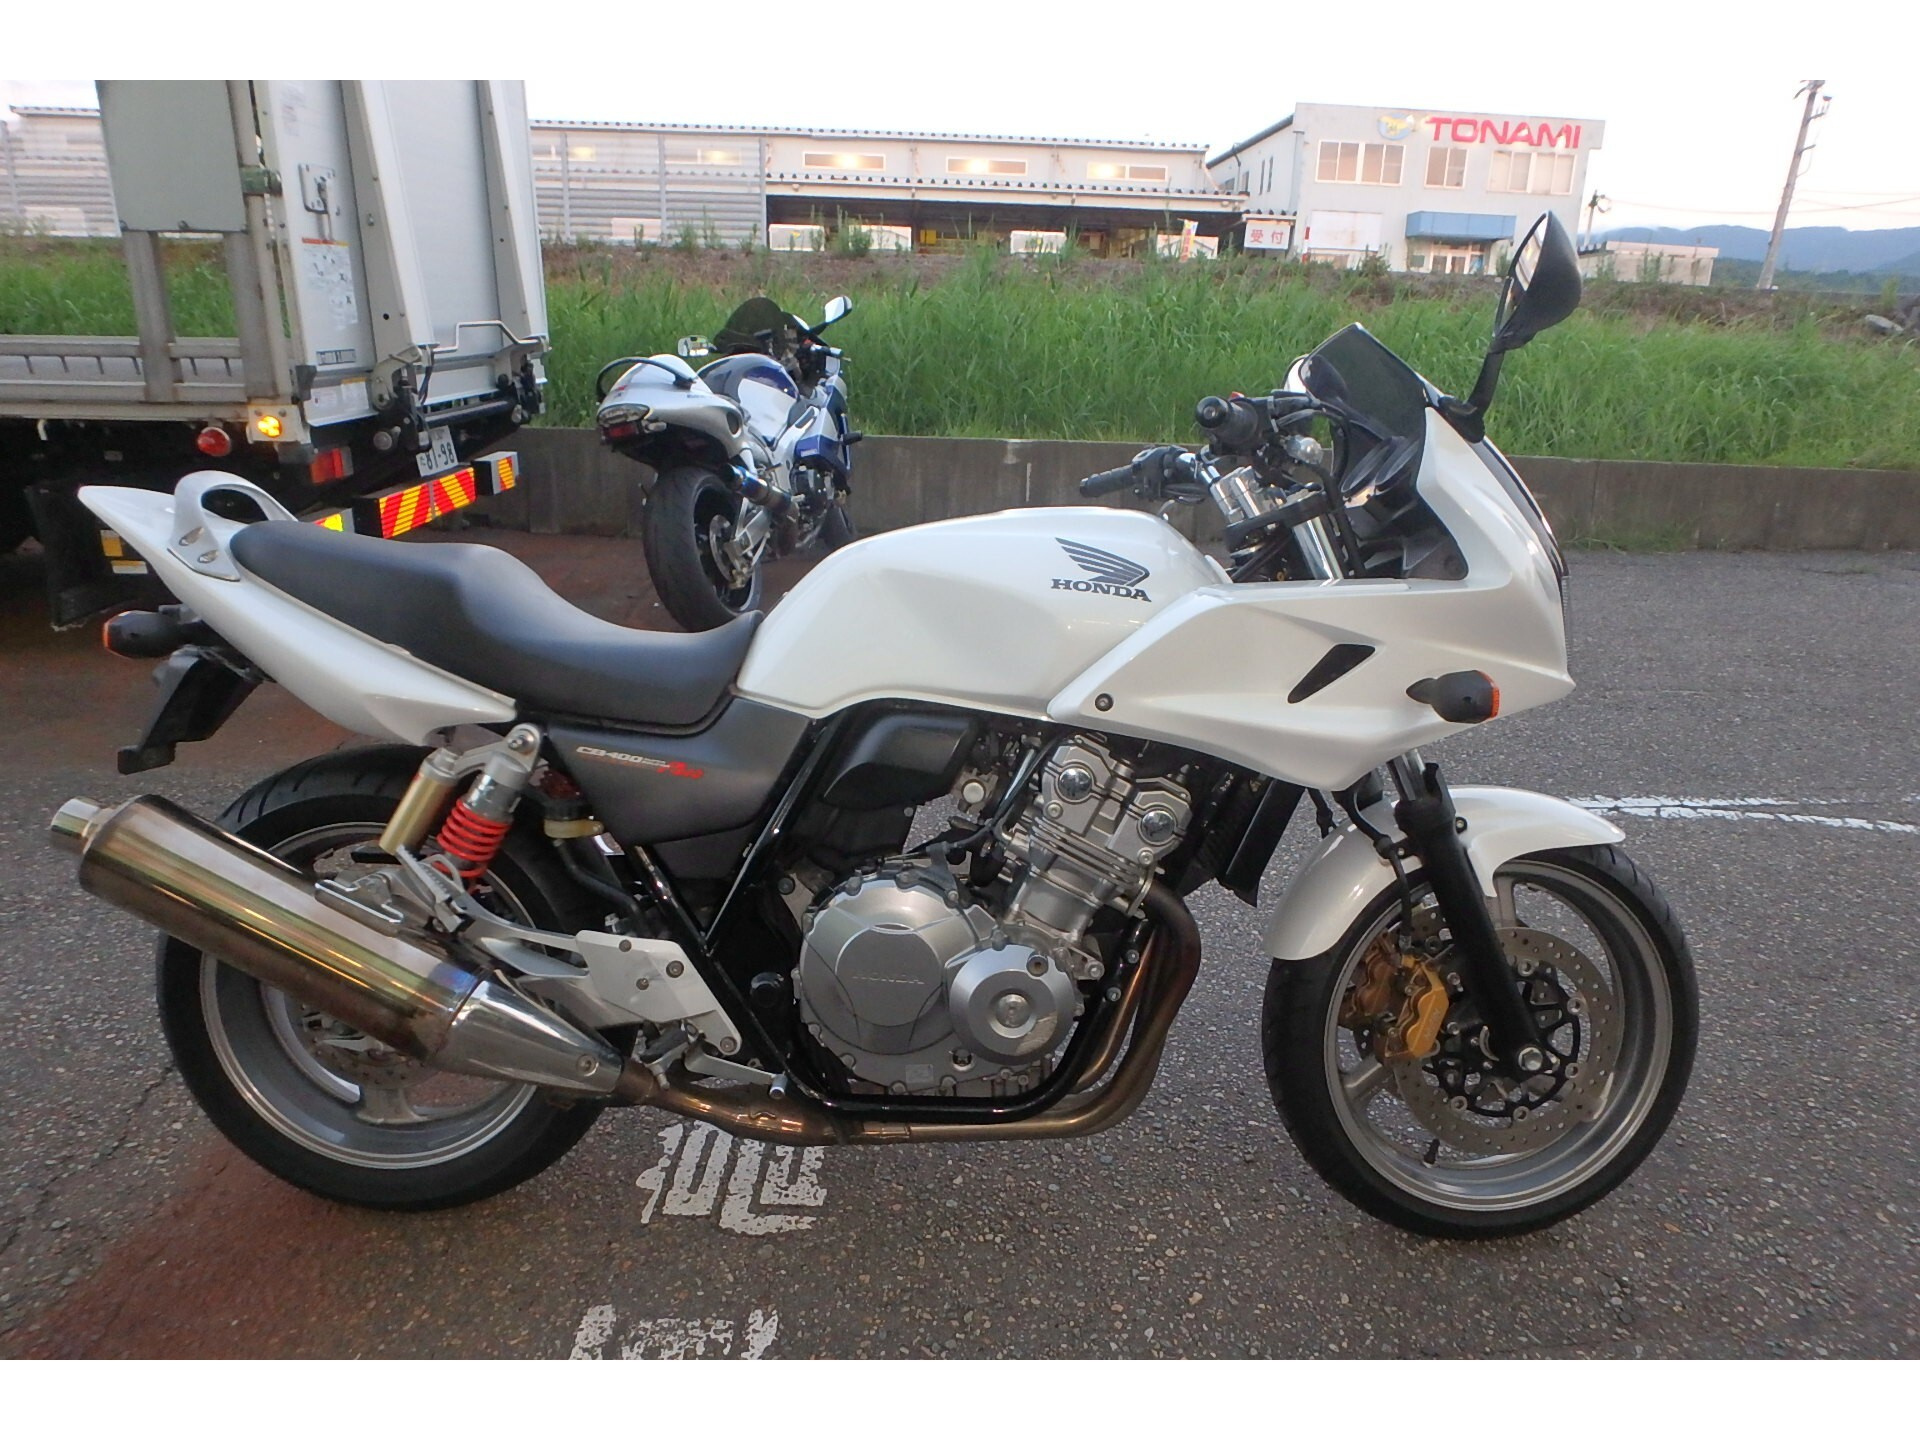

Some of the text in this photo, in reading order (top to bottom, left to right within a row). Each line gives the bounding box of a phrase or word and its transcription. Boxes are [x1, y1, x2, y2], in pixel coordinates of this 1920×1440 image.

[1425, 116, 1582, 149] TONAMI
[1249, 229, 1284, 244] 受付
[1051, 579, 1152, 602] HONDA
[576, 746, 643, 763] CB400
